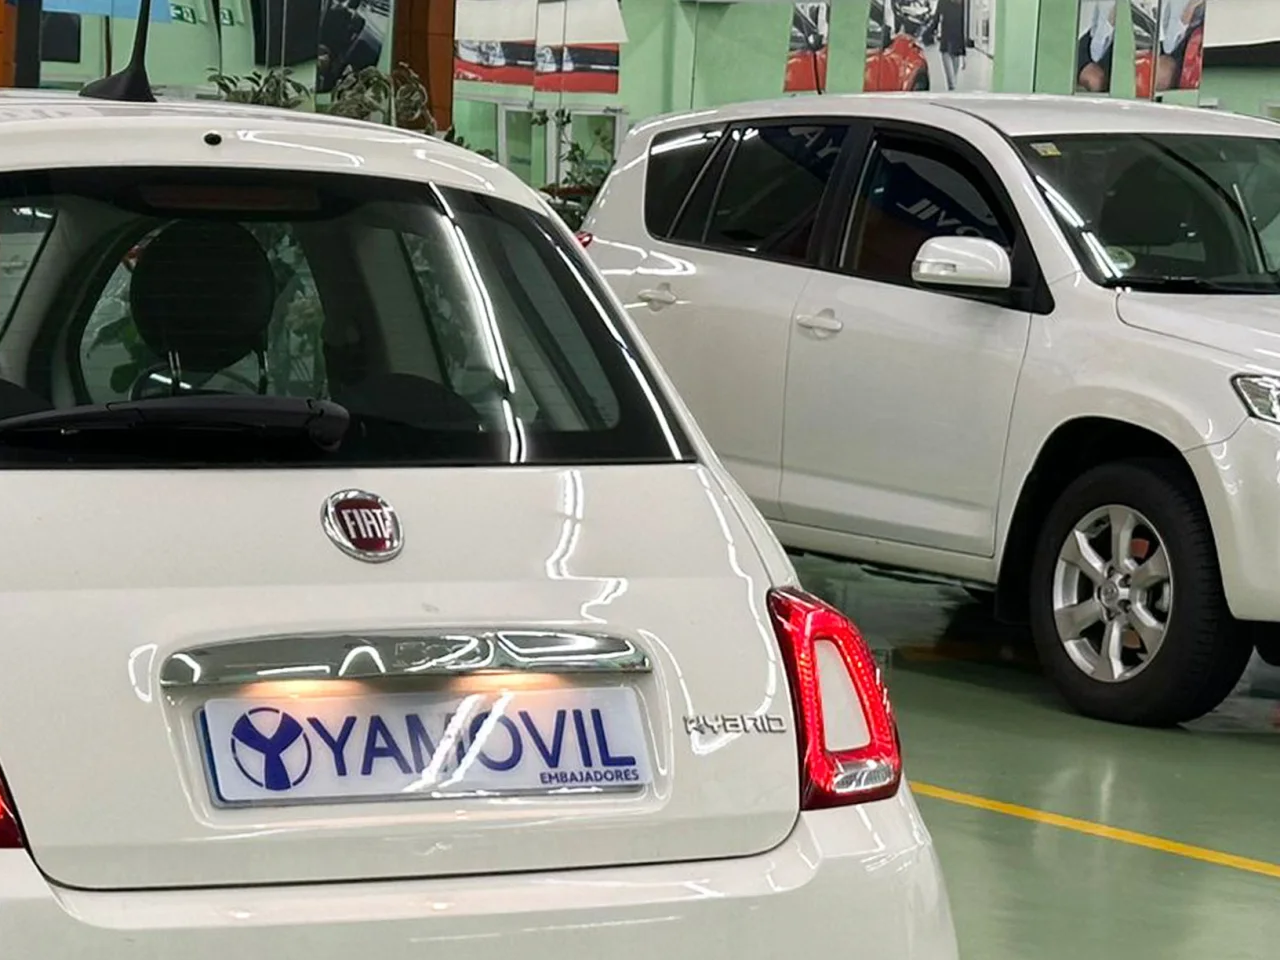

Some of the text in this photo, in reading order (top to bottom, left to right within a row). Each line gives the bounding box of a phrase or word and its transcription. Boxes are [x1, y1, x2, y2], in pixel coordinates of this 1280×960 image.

[340, 508, 391, 539] FIAT
[682, 714, 787, 735] HYBRID
[307, 708, 636, 777] YAMOVIL
[540, 768, 639, 784] EMBAJADORES
